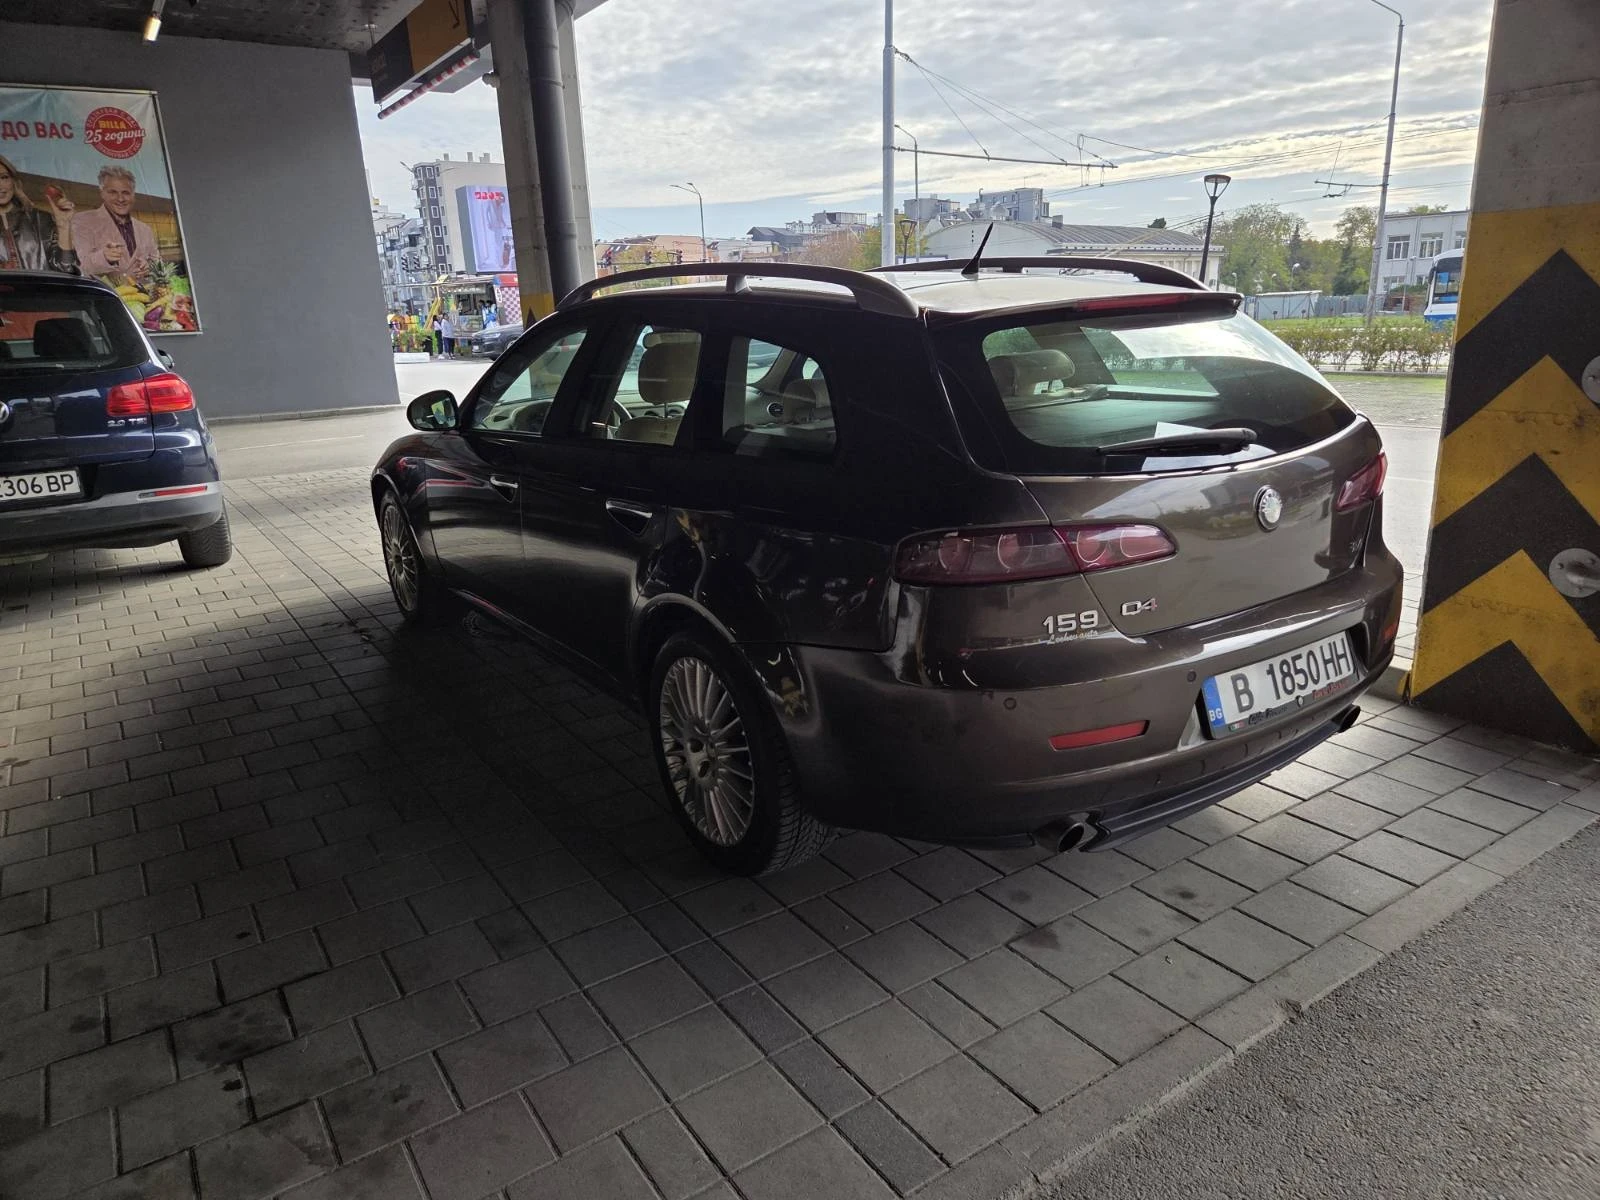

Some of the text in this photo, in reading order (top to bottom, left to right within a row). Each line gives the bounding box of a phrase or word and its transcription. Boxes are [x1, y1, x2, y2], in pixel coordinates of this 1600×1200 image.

[2, 120, 74, 141] ДО ВАС
[98, 120, 127, 129] BILLA
[85, 129, 147, 145] 25 години
[0, 473, 74, 497] 306 BP
[1042, 609, 1099, 635] 159
[1208, 707, 1223, 722] BG
[1230, 672, 1255, 714] B
[1266, 649, 1321, 701] 1850
[1319, 637, 1351, 681] HH
